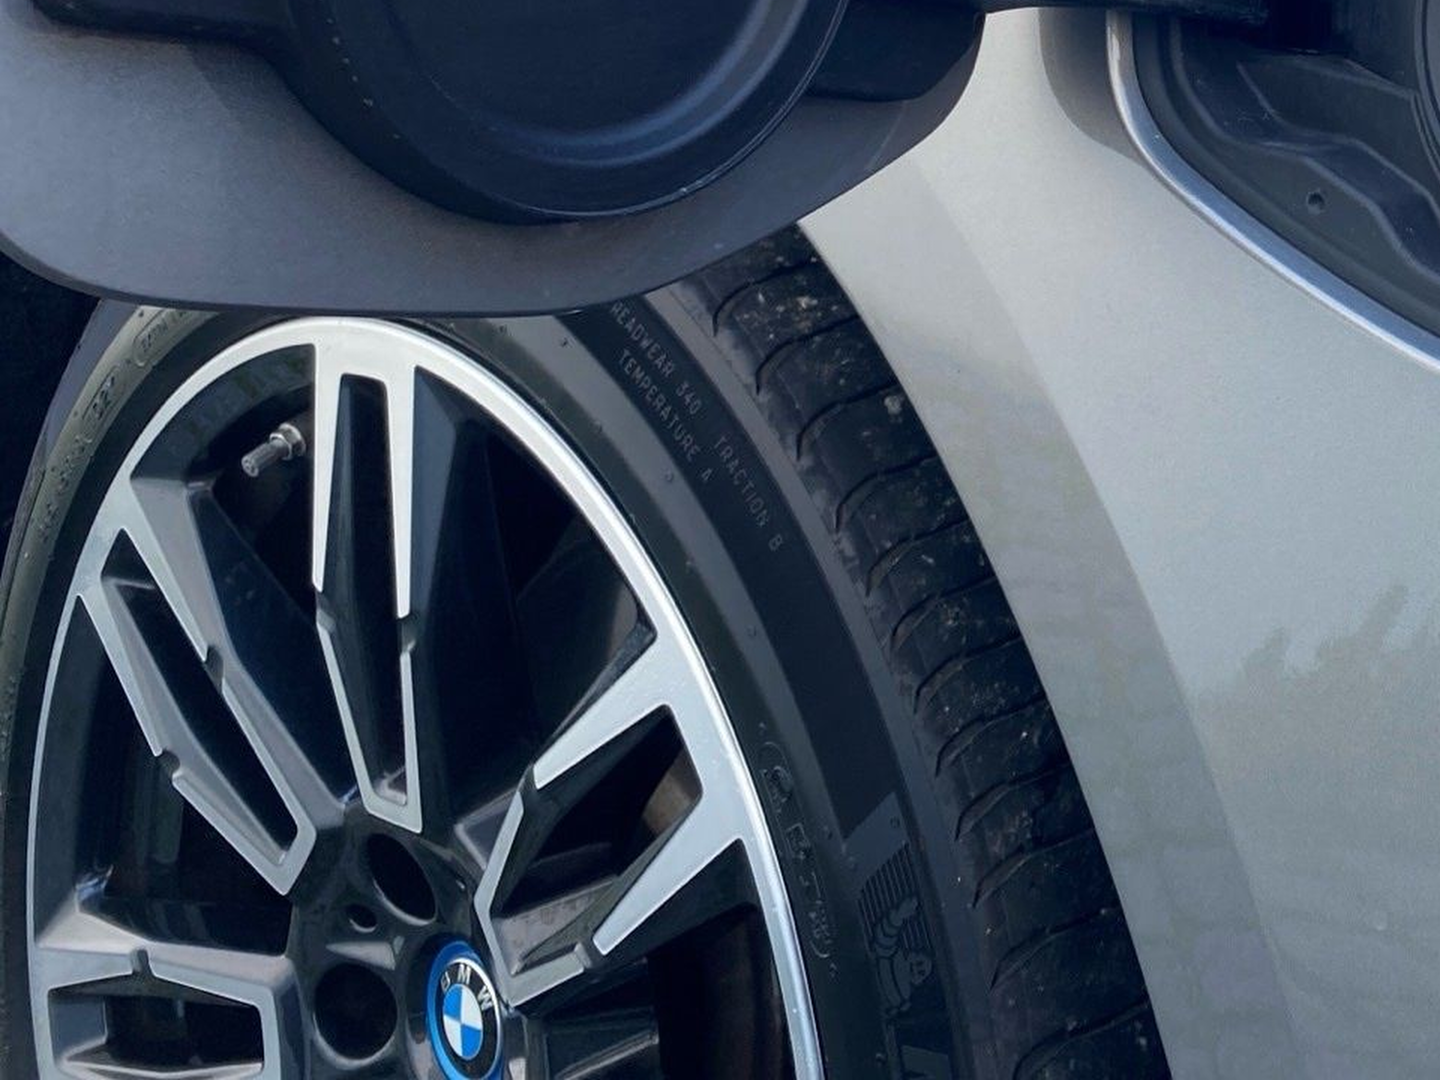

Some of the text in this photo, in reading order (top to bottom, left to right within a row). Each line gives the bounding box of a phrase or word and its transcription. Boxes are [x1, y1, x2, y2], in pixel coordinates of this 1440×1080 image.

[608, 301, 674, 378] READWEAR
[713, 435, 770, 527] TRACTION
[617, 349, 700, 462] TEMPERATURE
[440, 963, 494, 1011] BMW
